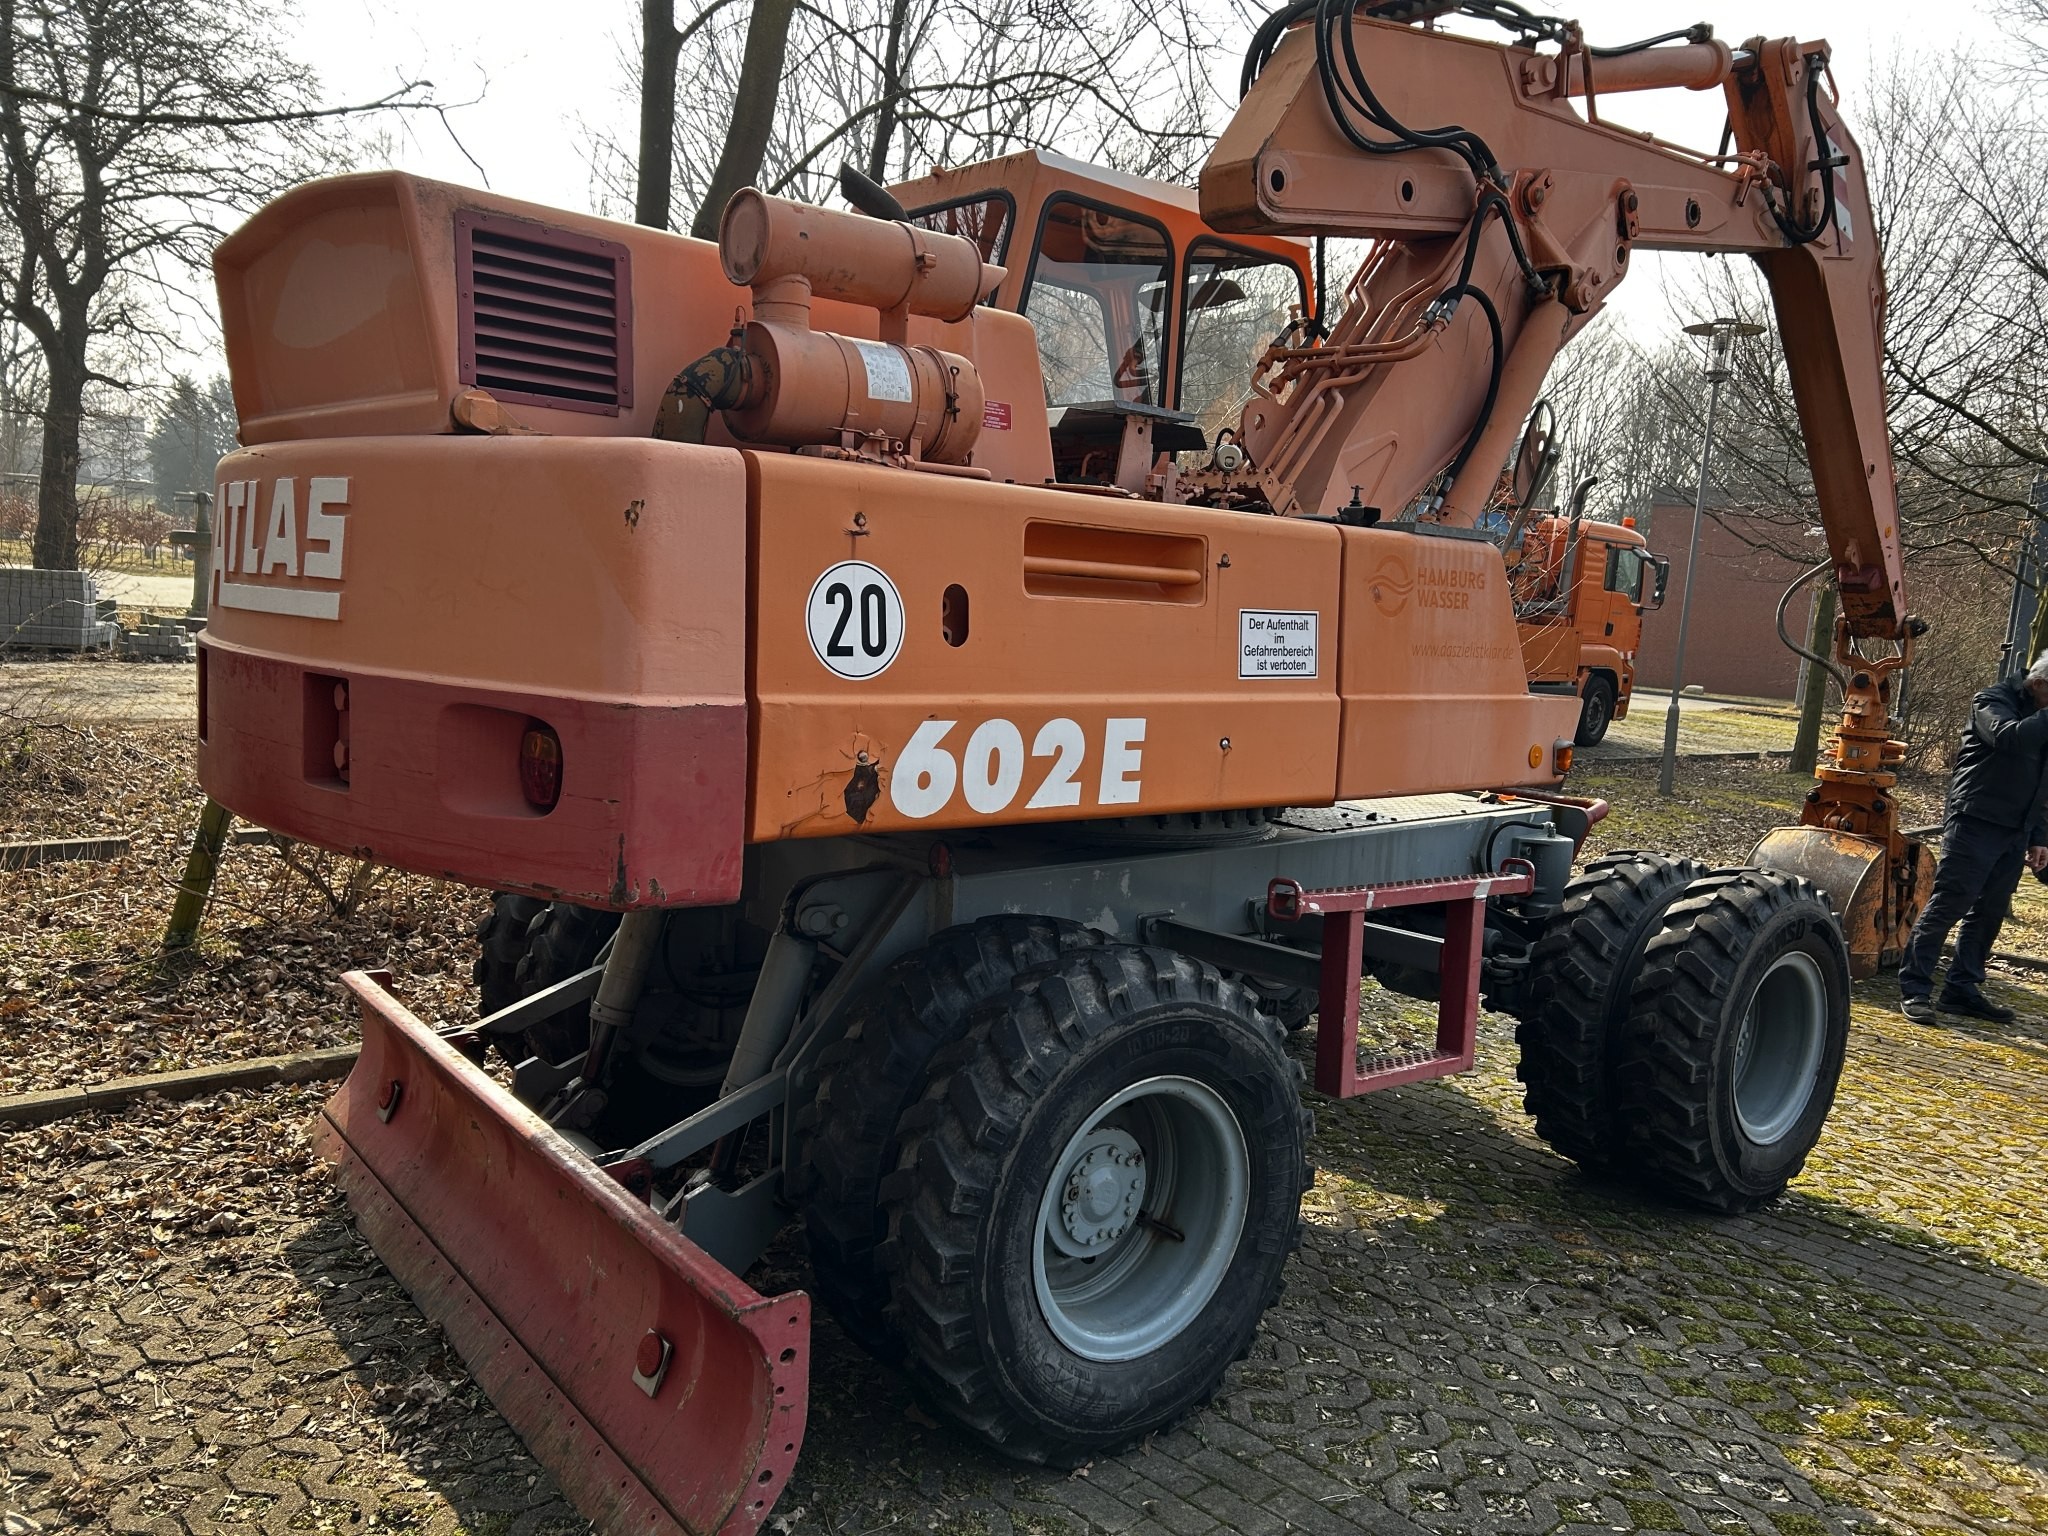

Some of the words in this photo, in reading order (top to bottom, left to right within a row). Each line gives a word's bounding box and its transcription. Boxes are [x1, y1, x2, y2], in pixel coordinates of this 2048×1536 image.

[209, 477, 349, 606] ATLAS
[1417, 567, 1485, 590] HAMBURG
[1417, 589, 1469, 609] WASSER
[825, 582, 887, 658] 20
[1249, 618, 1265, 630] Der
[1267, 619, 1309, 631] Aufenthalt
[1274, 633, 1285, 644] im
[1244, 645, 1314, 657] Gefahrenbereich
[1256, 659, 1267, 671] ist
[1270, 659, 1307, 671] verboten
[890, 717, 1086, 818] 602
[1097, 717, 1147, 805] E
